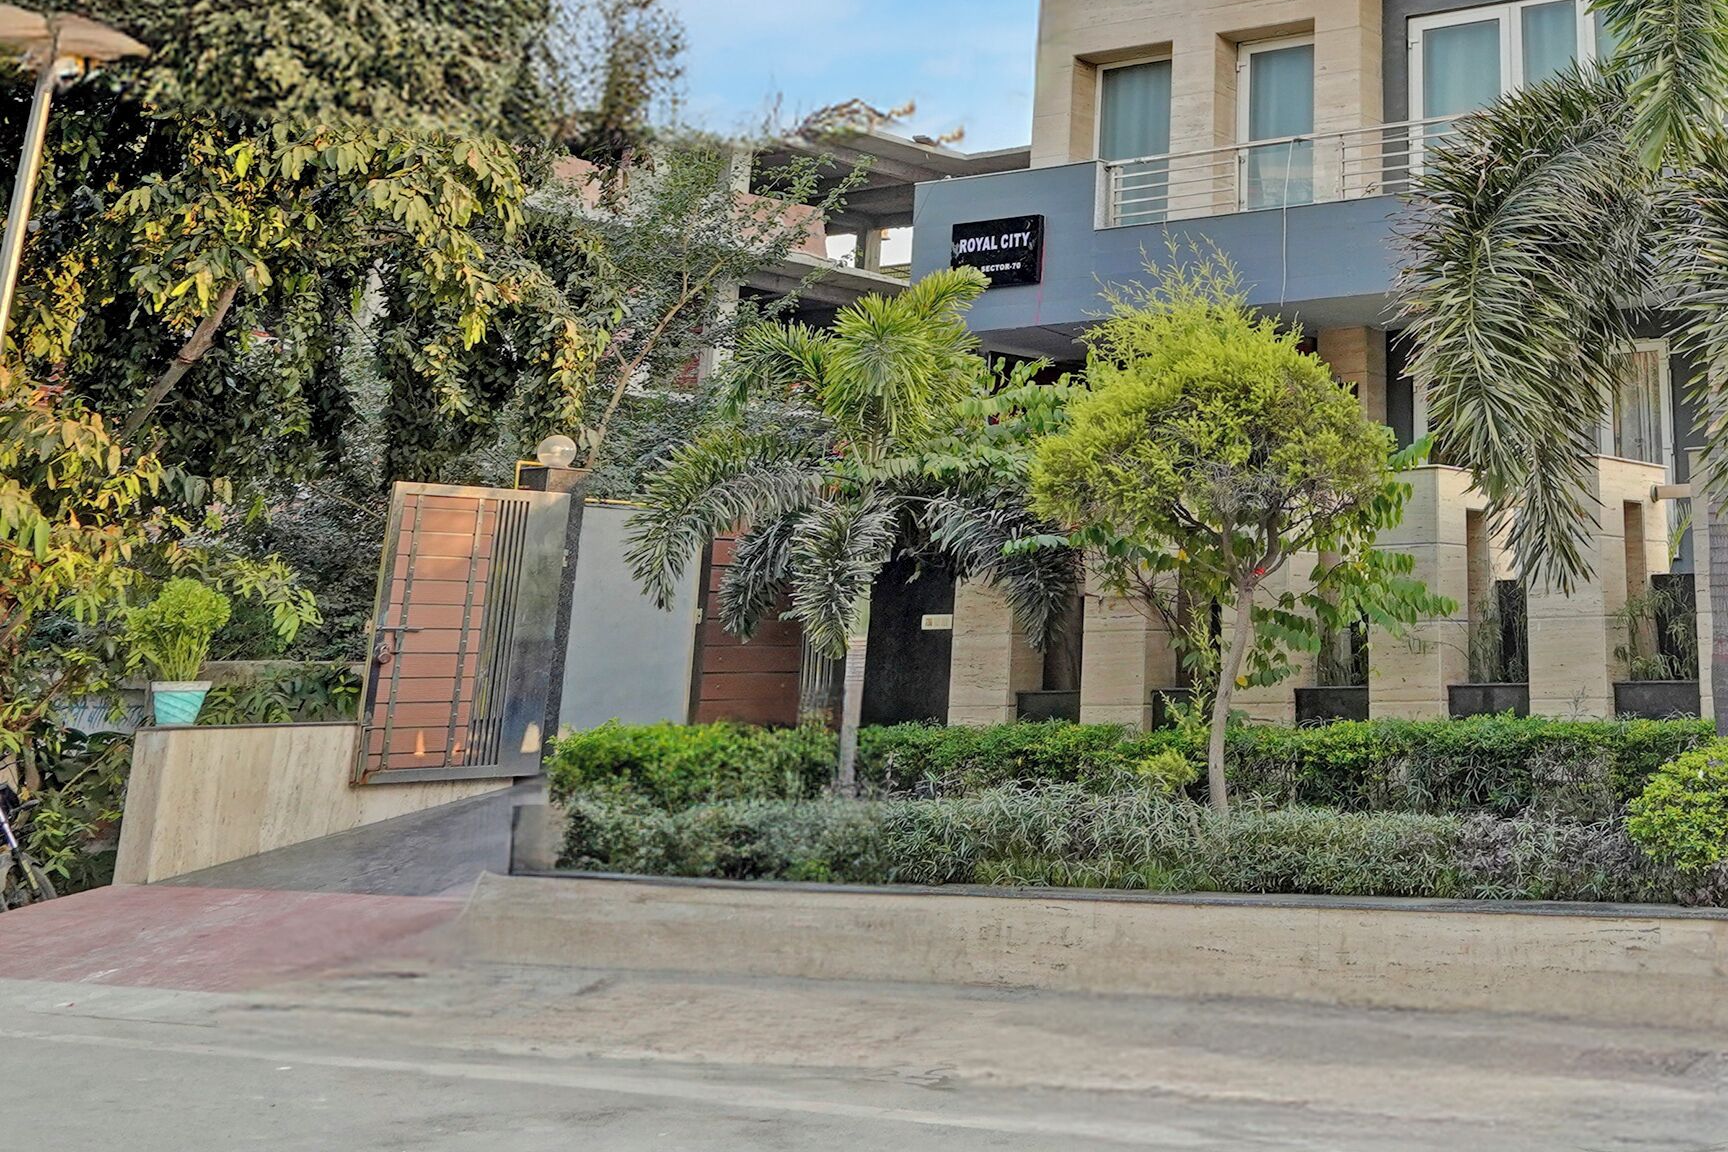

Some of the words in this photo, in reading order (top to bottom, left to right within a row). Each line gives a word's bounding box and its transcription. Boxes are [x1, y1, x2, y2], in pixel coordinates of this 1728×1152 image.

[960, 236, 998, 253] ROYAL
[1000, 232, 1031, 248] CITY
[981, 262, 1021, 273] SECTOR-70
